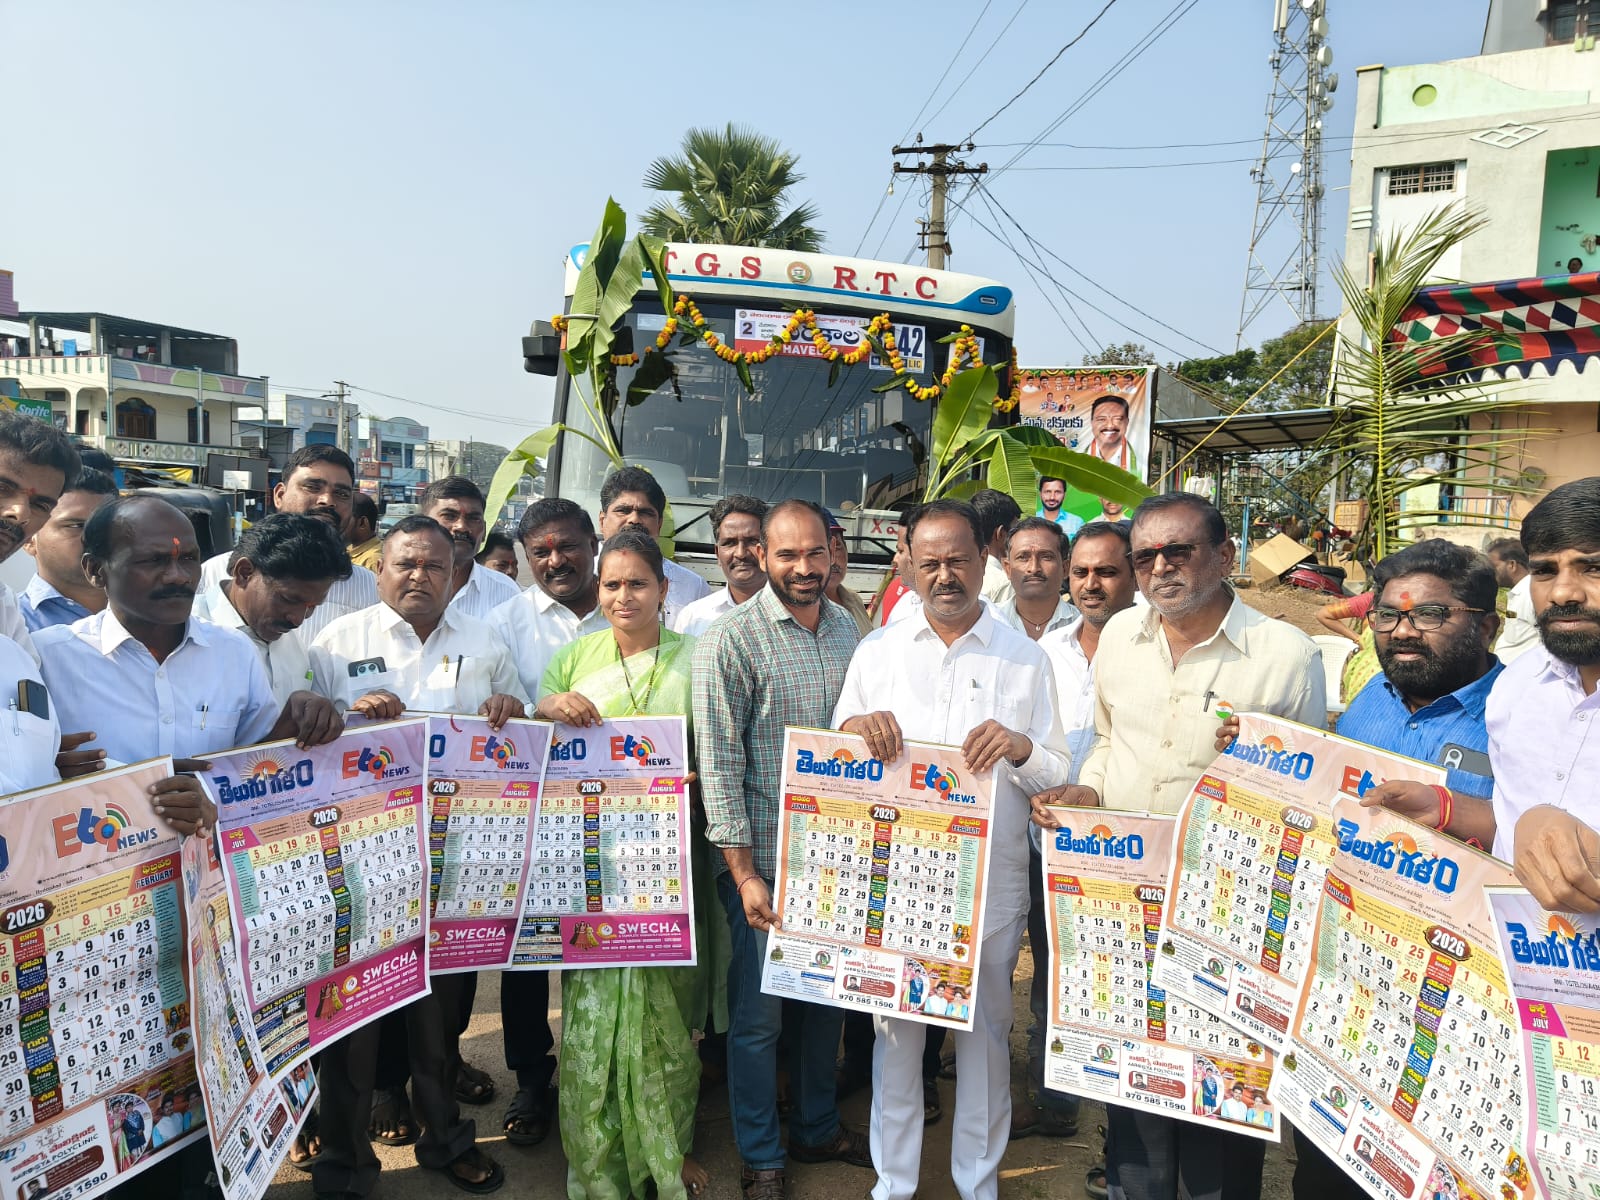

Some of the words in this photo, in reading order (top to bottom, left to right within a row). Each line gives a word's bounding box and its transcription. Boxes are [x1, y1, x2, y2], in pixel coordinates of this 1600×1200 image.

[834, 266, 938, 300] R.T.C
[742, 322, 753, 335] 2
[18, 404, 50, 417] Sprite
[504, 761, 530, 770] NEWS
[646, 758, 671, 766] NEWS
[796, 749, 841, 777] తెలుగు
[382, 766, 410, 778] NEWS
[213, 770, 267, 805] తెలుగు
[433, 782, 456, 793] 2026
[582, 782, 602, 793] 2026
[1200, 786, 1224, 800] JANUARY
[388, 796, 414, 808] AUGUST
[602, 798, 612, 806] 30
[620, 797, 625, 805] 2
[636, 796, 642, 804] 9
[650, 796, 659, 804] 16
[666, 796, 676, 804] 23
[947, 793, 976, 804] NEWS
[314, 808, 338, 824] 2026
[874, 806, 896, 820] 2026
[1286, 810, 1312, 829] 2026
[116, 828, 158, 850] NEWS
[254, 849, 260, 859] 5
[268, 844, 280, 855] 12
[286, 840, 298, 850] 19
[305, 834, 316, 844] 26
[341, 824, 350, 834] 30
[358, 820, 364, 830] 2
[373, 816, 379, 826] 9
[388, 812, 397, 822] 16
[404, 808, 414, 817] 23
[812, 816, 818, 824] 4
[828, 818, 837, 826] 11
[845, 819, 854, 828] 18
[862, 822, 871, 830] 25
[898, 827, 902, 835] 1
[914, 830, 920, 838] 8
[930, 832, 940, 840] 15
[947, 834, 958, 843] 22
[952, 826, 980, 834] FEBRUARY
[232, 839, 246, 849] JULY
[1056, 826, 1100, 855] తెలుగు
[1338, 818, 1395, 870] తెలుగు
[136, 868, 174, 888] FEBRUARY
[1140, 887, 1164, 901] 2026
[6, 902, 46, 930] 2026
[54, 924, 60, 936] 1
[82, 914, 90, 926] 8
[106, 902, 122, 917] 15
[132, 894, 146, 908] 22
[445, 927, 507, 942] SWECHA
[618, 922, 681, 934] SWECHA
[56, 950, 64, 962] 2
[86, 940, 94, 952] 9
[110, 929, 125, 942] 16
[136, 920, 150, 934] 23
[1432, 928, 1466, 956] 2026
[1505, 922, 1569, 968] తెలుగు
[362, 950, 418, 984] SWECHA
[1345, 912, 1352, 920] 4
[1363, 922, 1374, 935] 11
[1384, 933, 1398, 948] 18
[1408, 945, 1424, 960] 25
[1464, 971, 1470, 982] 1
[1486, 984, 1492, 996] 8
[1504, 999, 1514, 1015] 15
[838, 994, 854, 1002] 970
[874, 1000, 894, 1009] 1590
[1231, 1010, 1246, 1024] 970
[1267, 1031, 1284, 1044] 159
[1532, 1017, 1549, 1030] JULY
[1558, 1042, 1564, 1056] 5
[1577, 1046, 1590, 1061] 12
[1562, 1074, 1568, 1089] 6
[1581, 1080, 1594, 1095] 13
[1125, 1092, 1142, 1101] 970
[1144, 1096, 1161, 1106] 585
[1164, 1100, 1186, 1111] 1590
[52, 1134, 99, 1162] POLYCLINIC
[77, 1172, 108, 1194] 1590
[1345, 1154, 1362, 1172] 970
[1364, 1170, 1382, 1190] 585
[1384, 1186, 1398, 1200] 15
